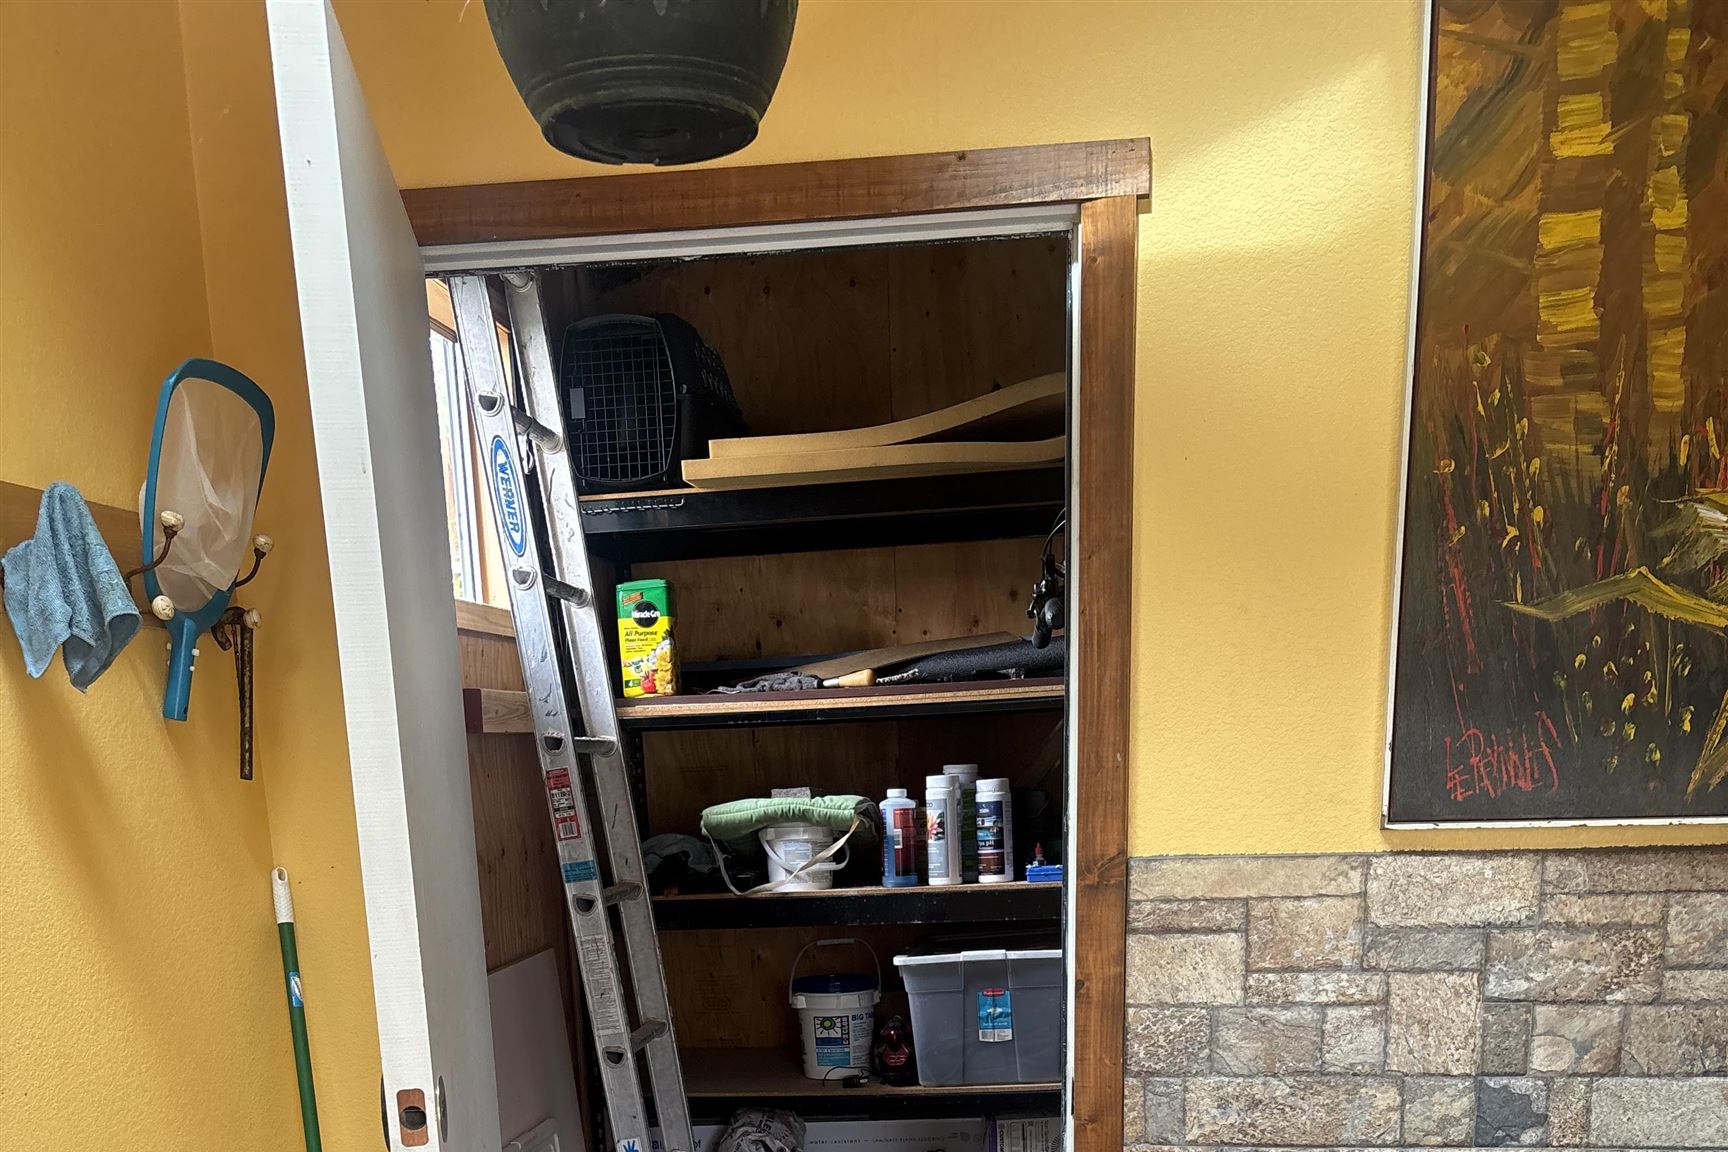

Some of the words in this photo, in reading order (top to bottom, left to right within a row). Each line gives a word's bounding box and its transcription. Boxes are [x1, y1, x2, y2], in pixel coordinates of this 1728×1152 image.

[498, 461, 520, 533] WERNER
[634, 630, 658, 638] Purpose
[851, 1013, 864, 1021] BIG
